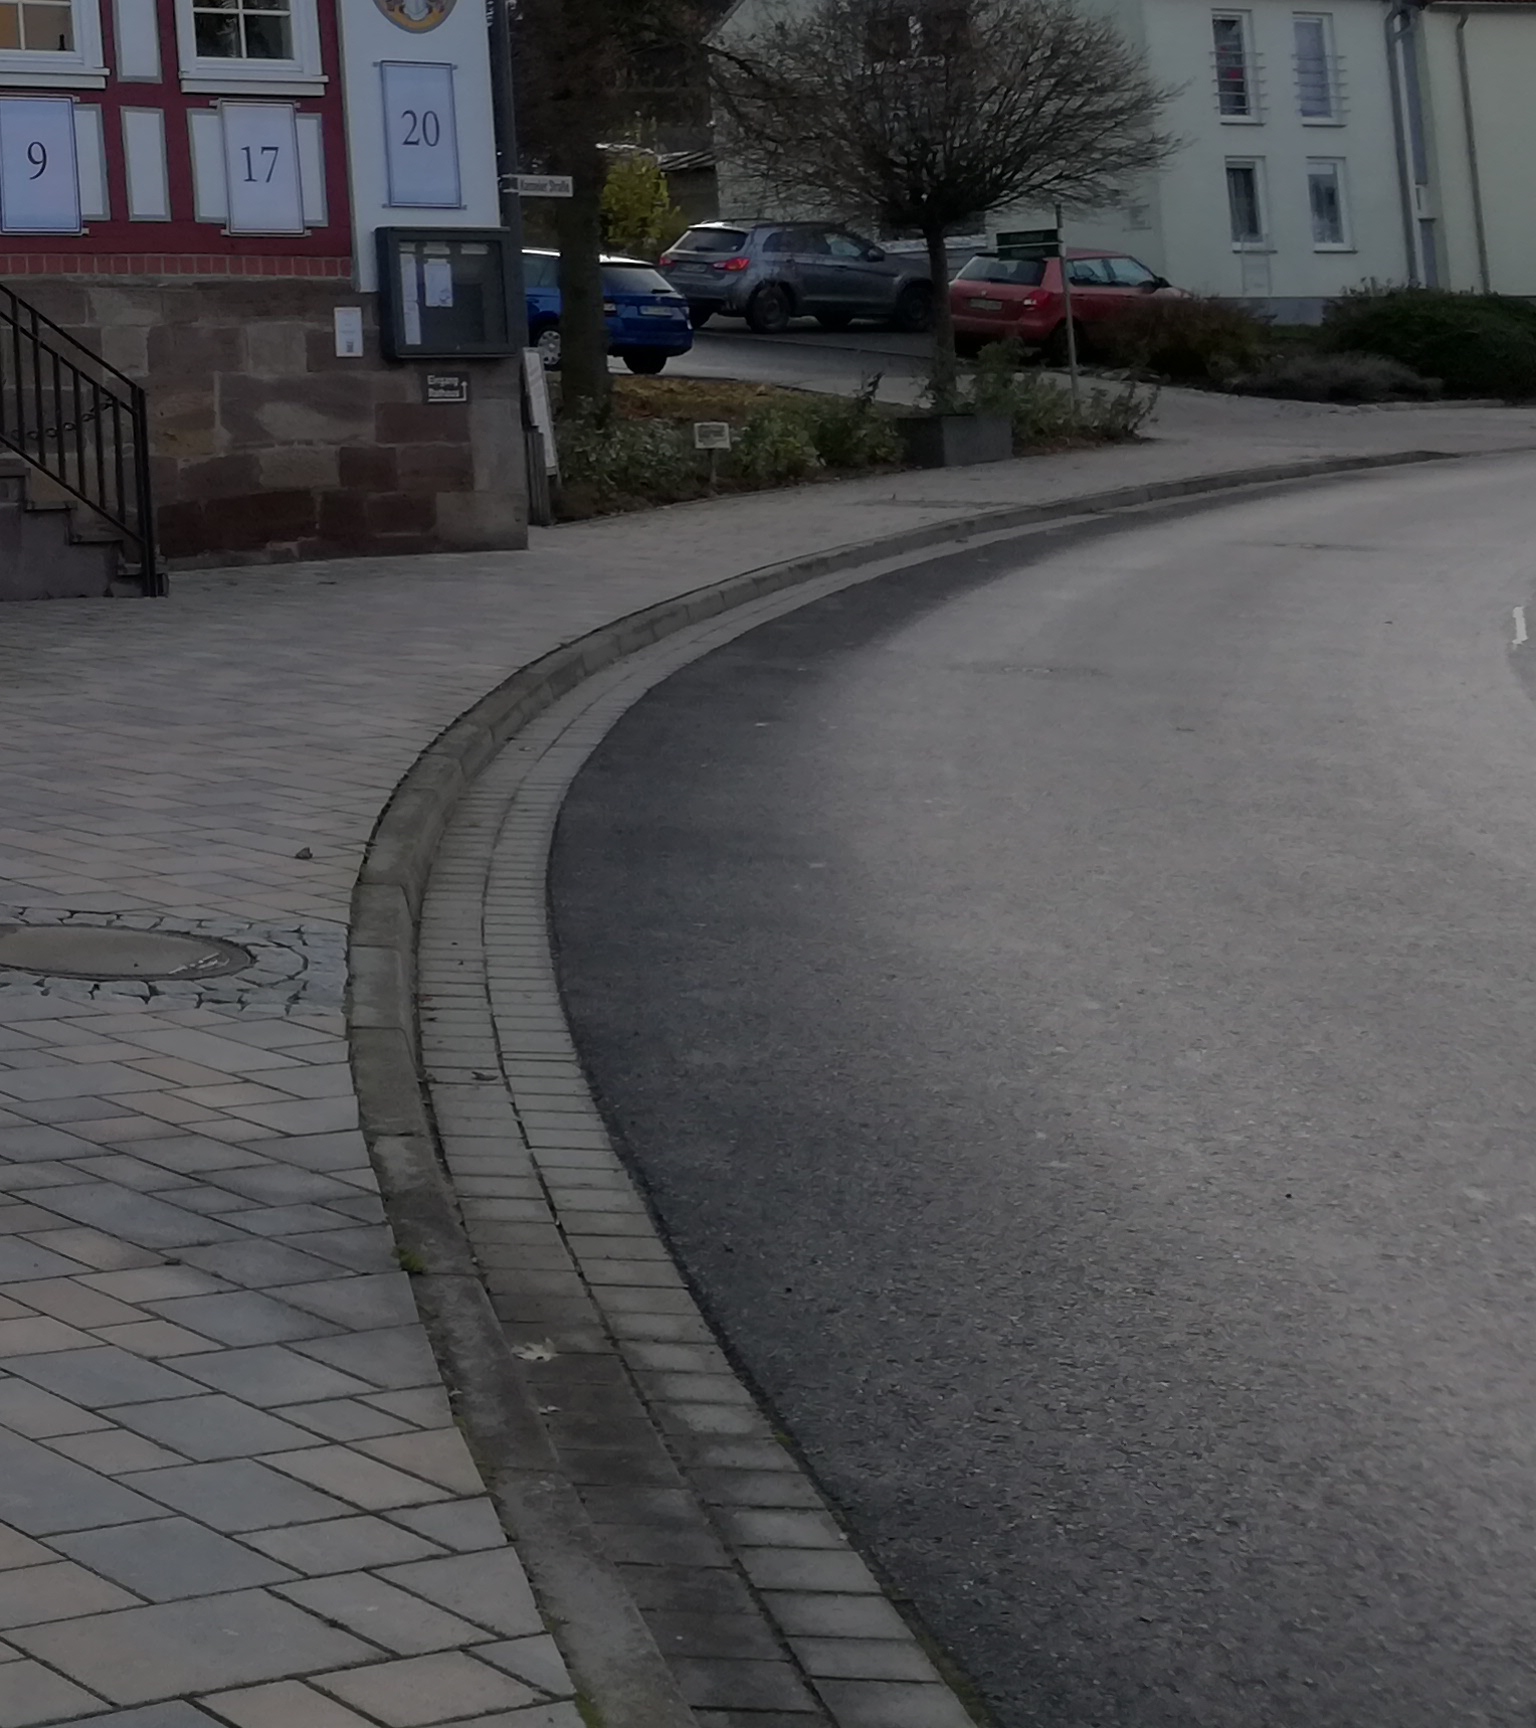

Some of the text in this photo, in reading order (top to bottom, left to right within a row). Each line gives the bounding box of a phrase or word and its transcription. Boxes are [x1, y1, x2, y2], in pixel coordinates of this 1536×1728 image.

[401, 109, 441, 147] 20
[26, 141, 47, 180] 9
[241, 146, 280, 183] 17
